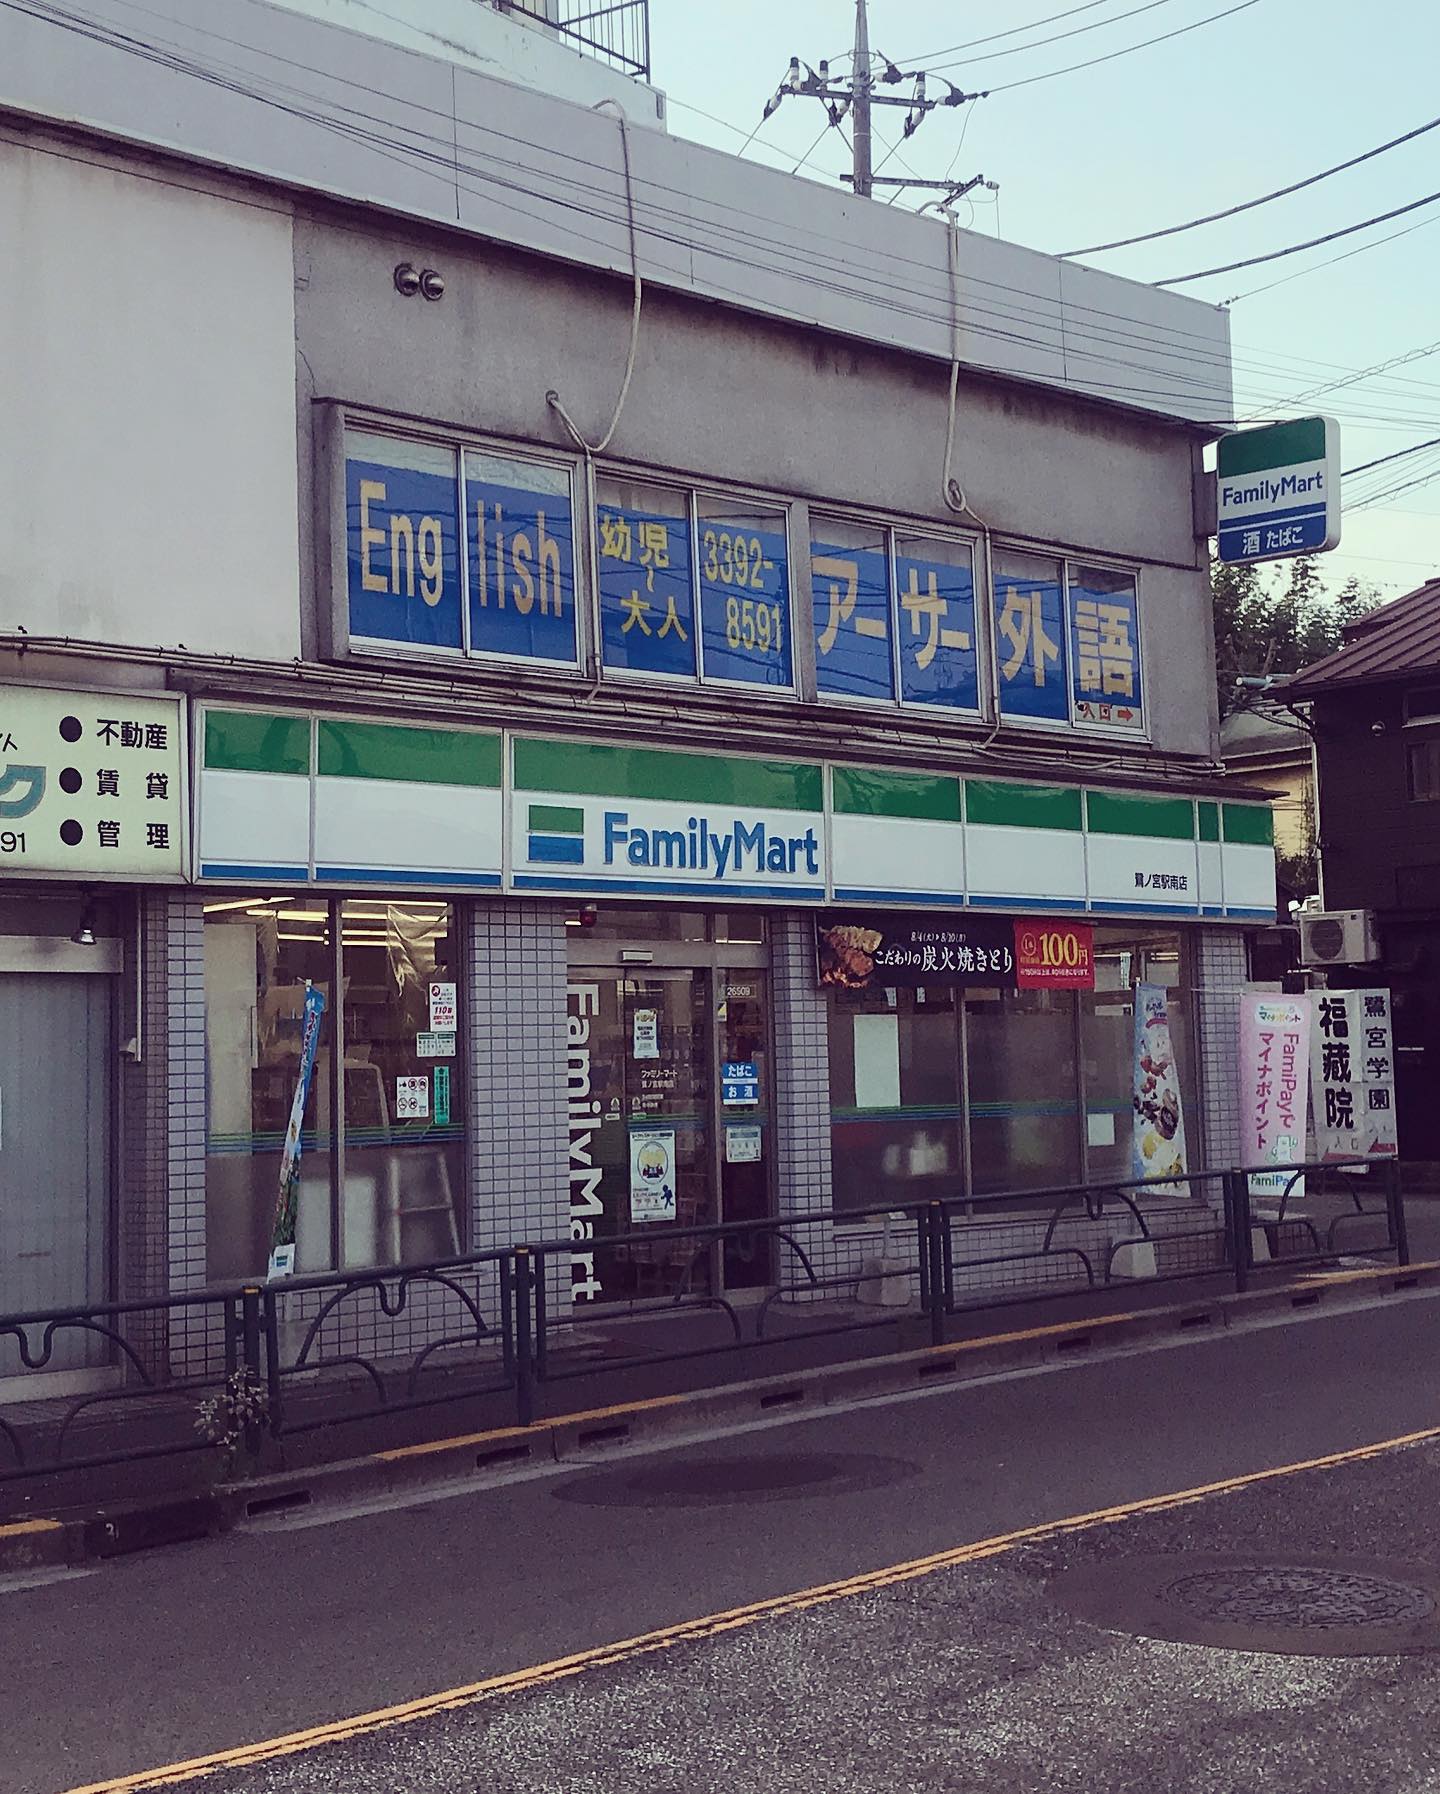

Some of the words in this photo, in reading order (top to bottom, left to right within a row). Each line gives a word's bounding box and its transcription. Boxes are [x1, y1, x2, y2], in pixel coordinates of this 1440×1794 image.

[1222, 471, 1323, 507] FamilyMart
[600, 515, 668, 568] 幼児
[703, 529, 774, 589] 3392-
[1242, 530, 1260, 555] 酒
[1266, 526, 1304, 549] たばこ
[621, 590, 688, 642] 大人
[725, 597, 783, 653] 8591
[97, 718, 168, 750] 不動産
[602, 811, 819, 880] FamilyMart
[727, 1065, 753, 1078] たばこ
[1255, 1033, 1274, 1150] マイナポイント
